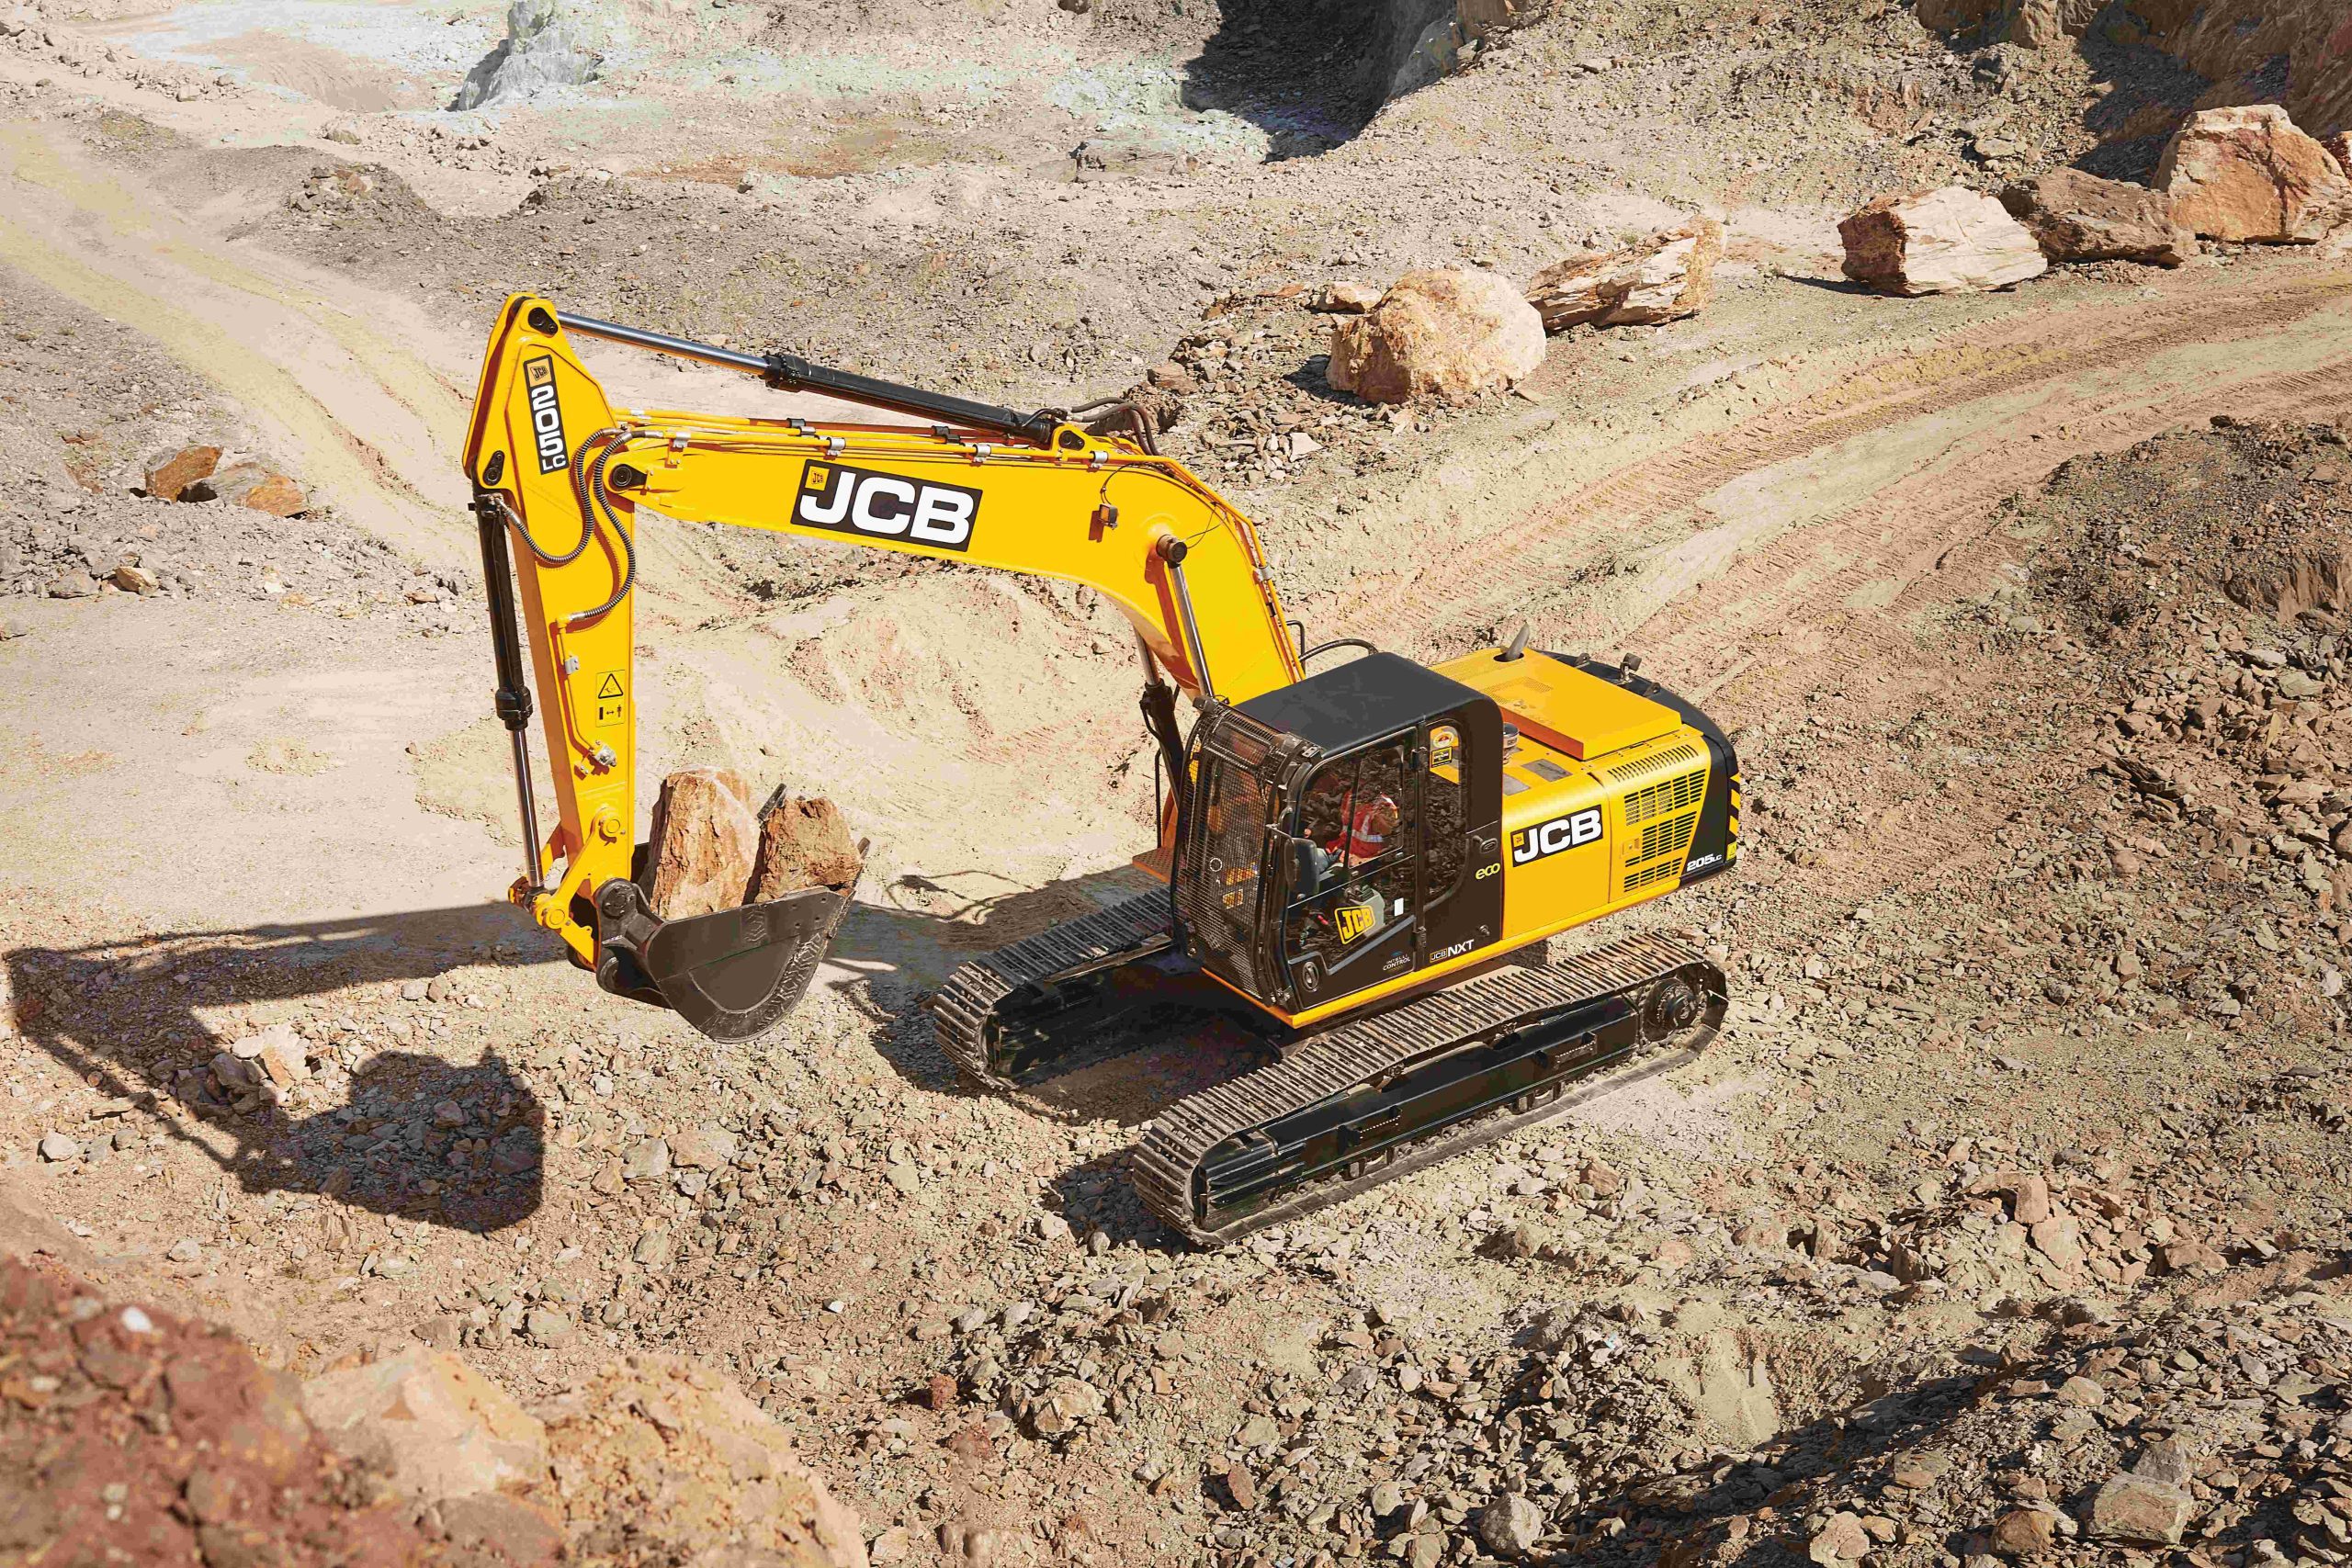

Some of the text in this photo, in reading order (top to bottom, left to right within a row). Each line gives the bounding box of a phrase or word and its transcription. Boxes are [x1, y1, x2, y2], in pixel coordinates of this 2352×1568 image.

[533, 367, 548, 378] JCB
[531, 385, 563, 457] 205
[542, 455, 566, 470] LC
[799, 471, 974, 544] JCB
[1514, 809, 1601, 863] JCB
[1476, 863, 1500, 879] eco
[1342, 908, 1373, 939] JCB
[1431, 939, 1474, 960] JCB NXT
[1383, 957, 1410, 970] CONTROL
